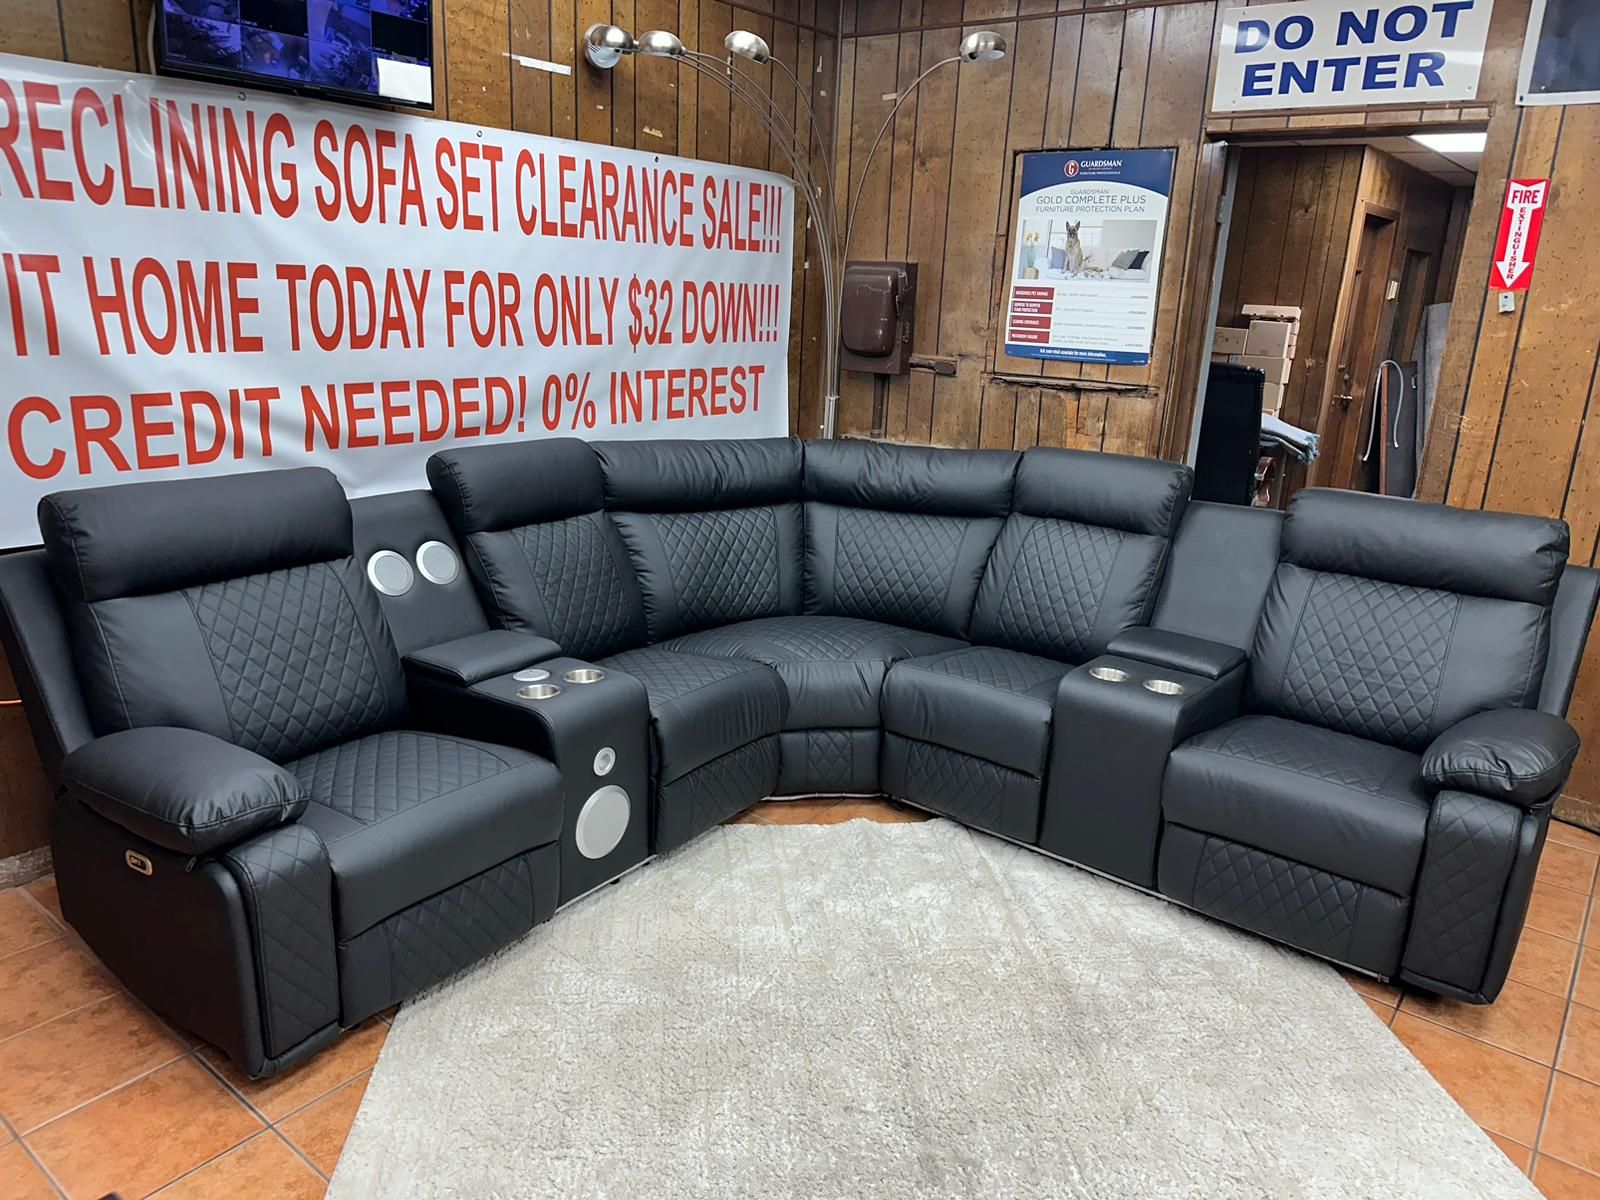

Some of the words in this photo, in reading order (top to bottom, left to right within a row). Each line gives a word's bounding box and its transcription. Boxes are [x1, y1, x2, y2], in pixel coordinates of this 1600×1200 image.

[1233, 15, 1314, 54] DO
[1335, 0, 1475, 46] NOT
[1241, 51, 1447, 98] ENTER
[0, 78, 301, 220] RECLINING
[313, 119, 429, 228] SOFA
[435, 137, 504, 233] SET
[515, 148, 695, 249] CLEARANCE
[702, 174, 783, 255] SALE!!!
[1080, 160, 1122, 168] GUARDSMAN
[1035, 205, 1074, 213] FURNITURE
[1075, 205, 1122, 213] PROTECTION
[1124, 205, 1145, 213] PLAN
[1036, 195, 1063, 204] GOLD
[1065, 194, 1117, 204] COMPLETE
[1120, 194, 1146, 204] PLUS
[1511, 189, 1540, 204] FIRE
[1506, 206, 1527, 280] EXTINGUISHER
[2, 253, 62, 357] IT
[82, 255, 265, 356] HOME
[275, 262, 432, 352] TODAY
[444, 270, 525, 349] FOR
[533, 273, 620, 347] ONLY
[628, 273, 674, 353] $32
[682, 280, 781, 346] DOWN!!!
[7, 386, 281, 480] CREDIT
[300, 375, 527, 453] NEEDED!
[541, 371, 597, 431] 0%
[609, 365, 766, 425] INTEREST
